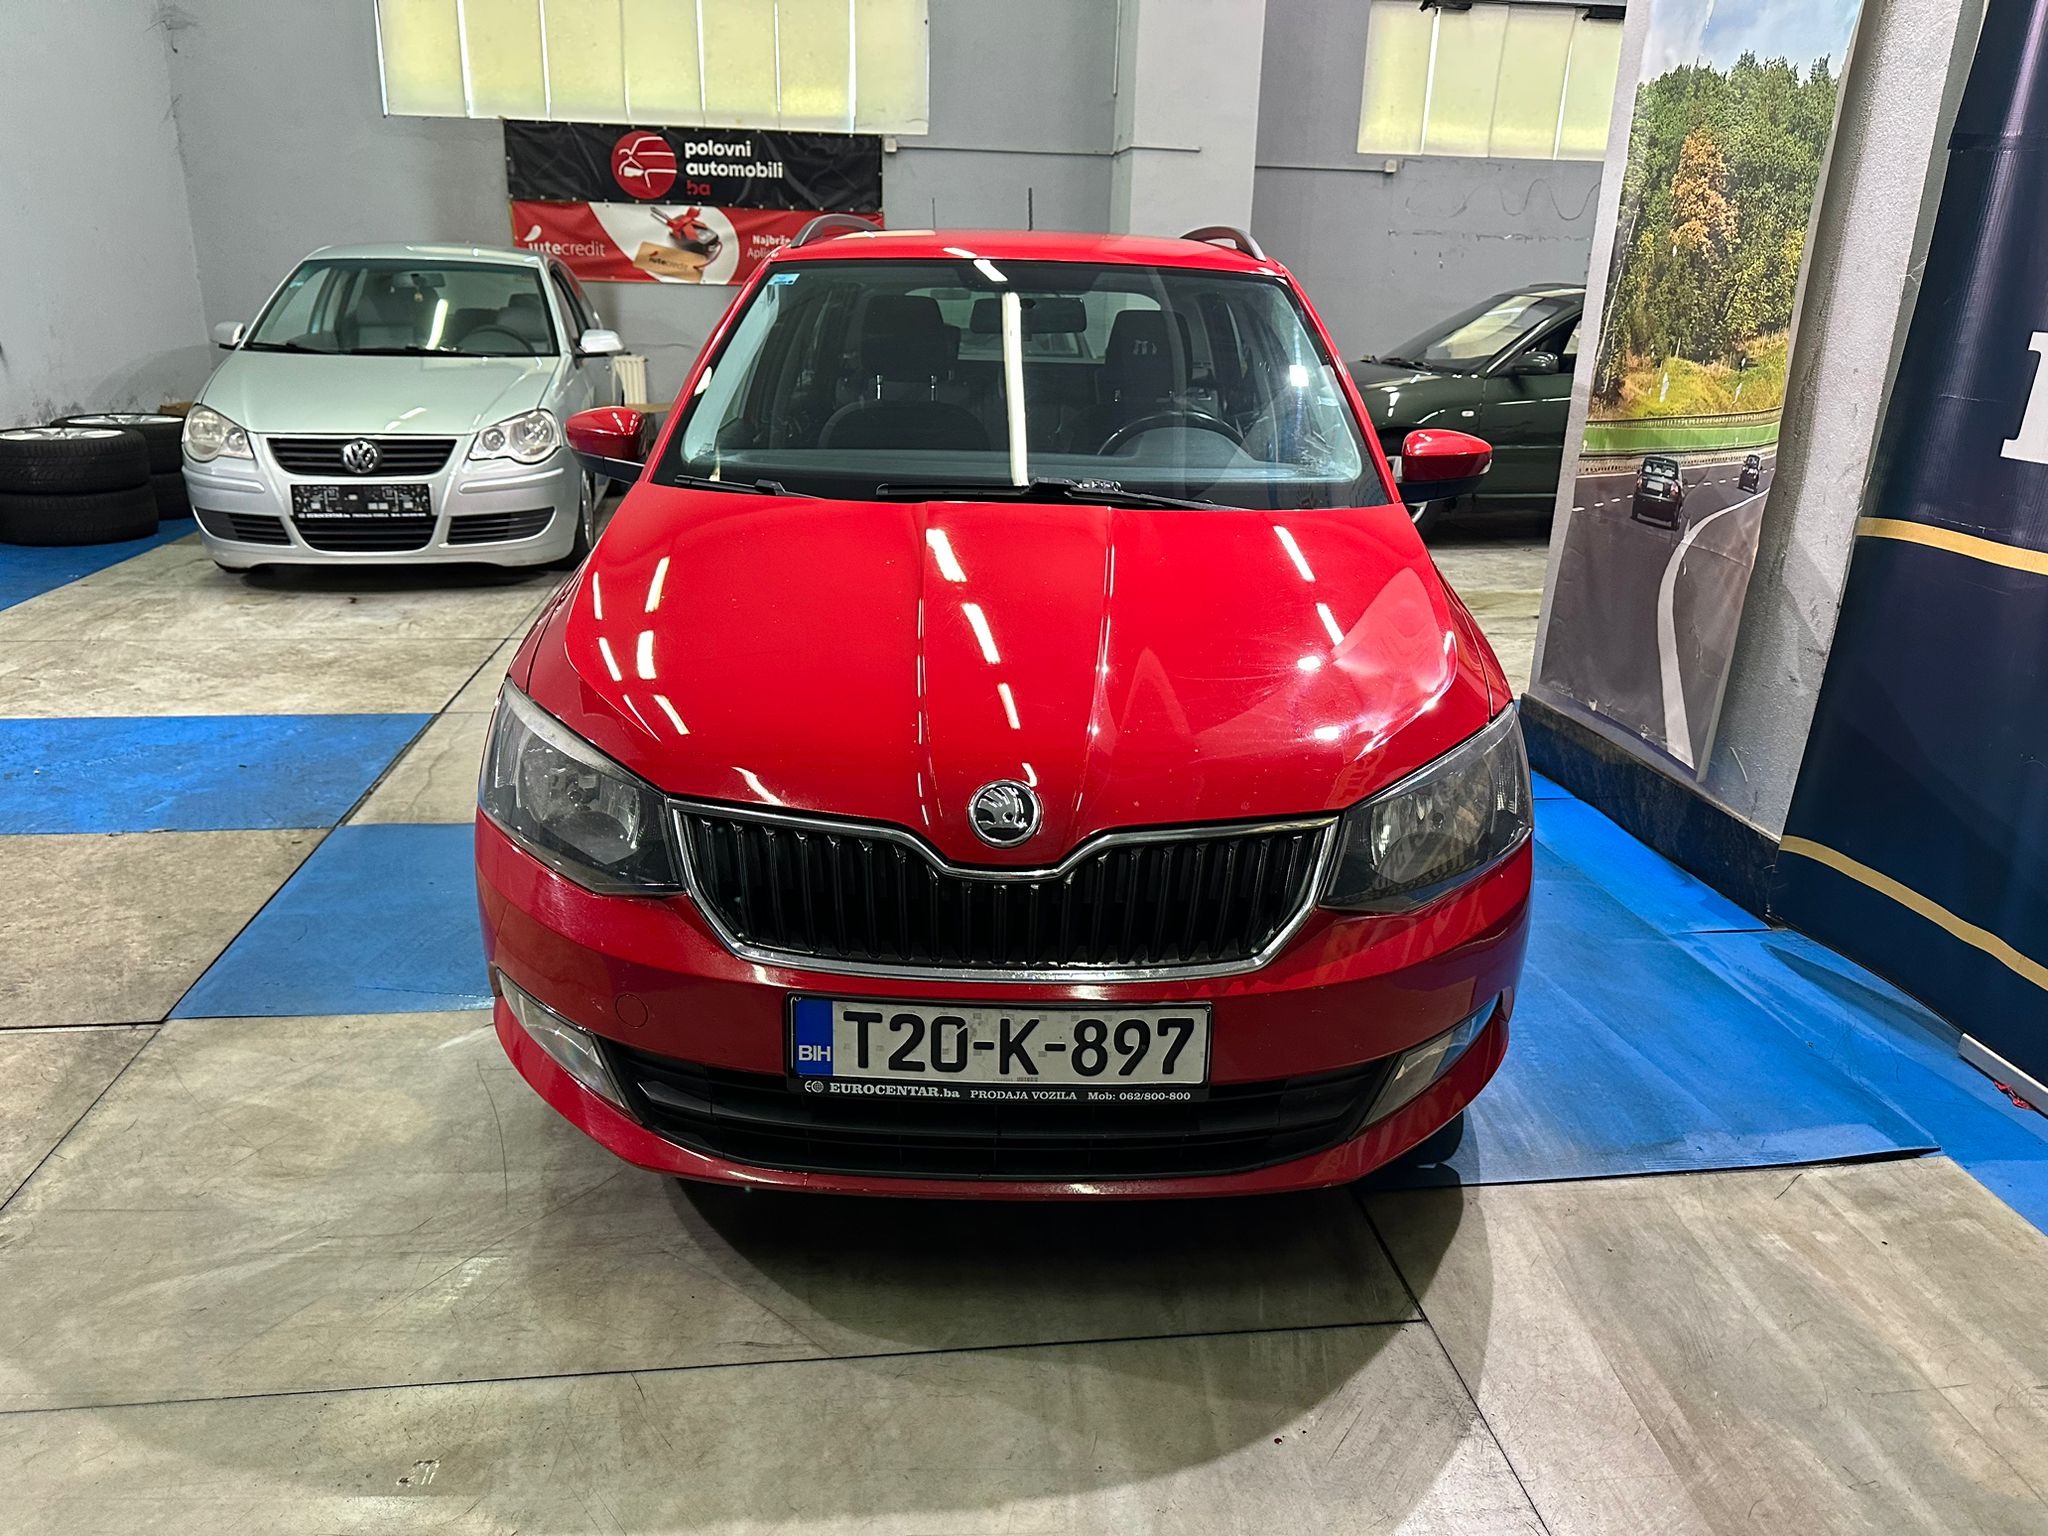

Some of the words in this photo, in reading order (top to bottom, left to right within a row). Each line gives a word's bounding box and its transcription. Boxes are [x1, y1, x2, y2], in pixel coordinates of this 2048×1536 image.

[684, 139, 752, 159] polovni
[685, 160, 784, 179] automobili
[843, 1010, 1195, 1077] T20-K-897
[798, 1045, 832, 1062] BIH
[829, 1082, 961, 1098] EUROCENTAR.ba
[970, 1089, 1029, 1100] PRODAJA
[1031, 1090, 1078, 1100] VOZILA
[1087, 1091, 1116, 1101] Mob:
[1119, 1091, 1191, 1101] 062/800-800
